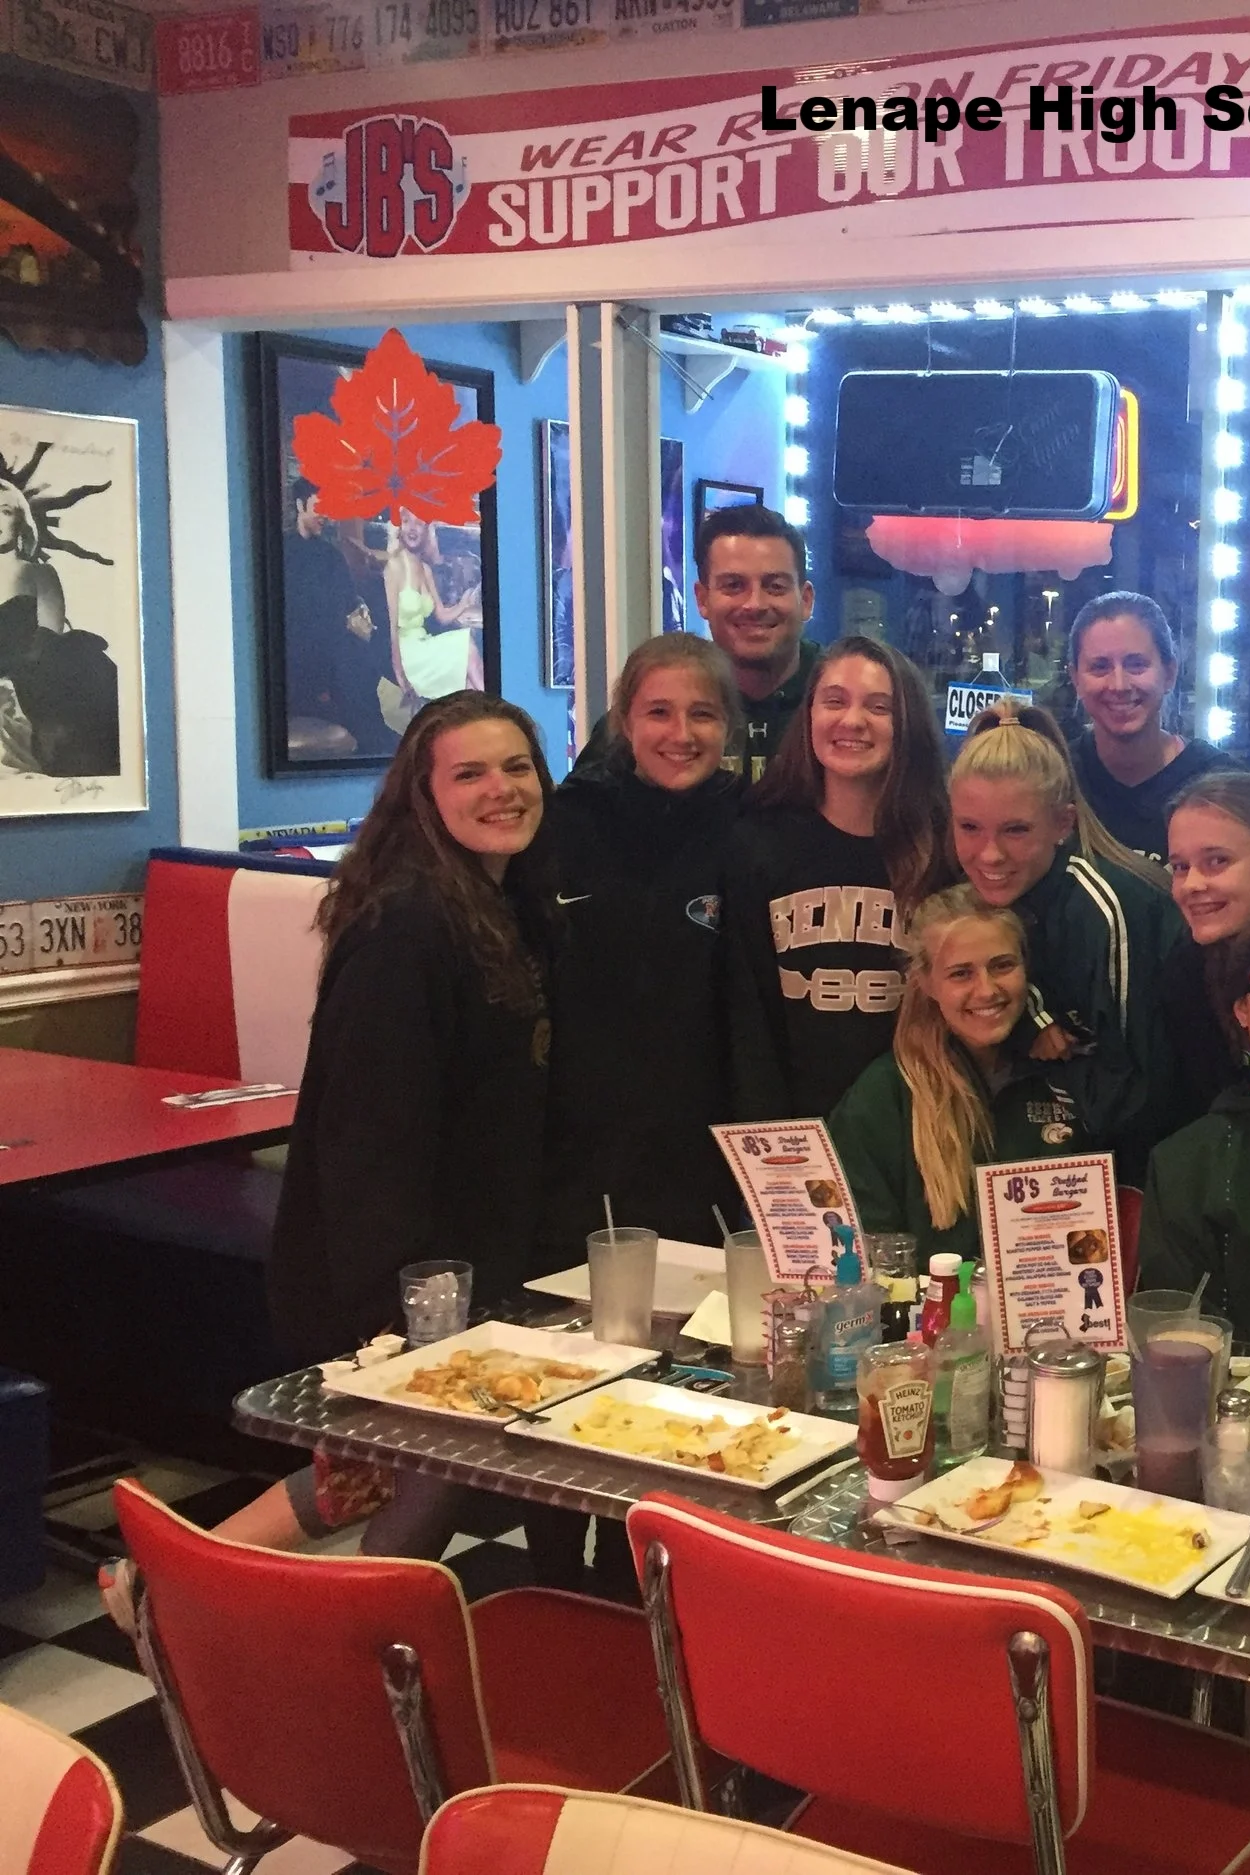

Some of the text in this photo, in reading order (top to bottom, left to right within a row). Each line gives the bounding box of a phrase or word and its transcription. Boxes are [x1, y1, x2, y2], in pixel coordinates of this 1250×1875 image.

[520, 123, 698, 172] WEAR
[488, 142, 796, 247] SUPPORT
[40, 914, 87, 953] 3XN
[1003, 1175, 1041, 1204] JB'S
[890, 1401, 925, 1417] TOMATO
[895, 1387, 922, 1401] HEINZ
